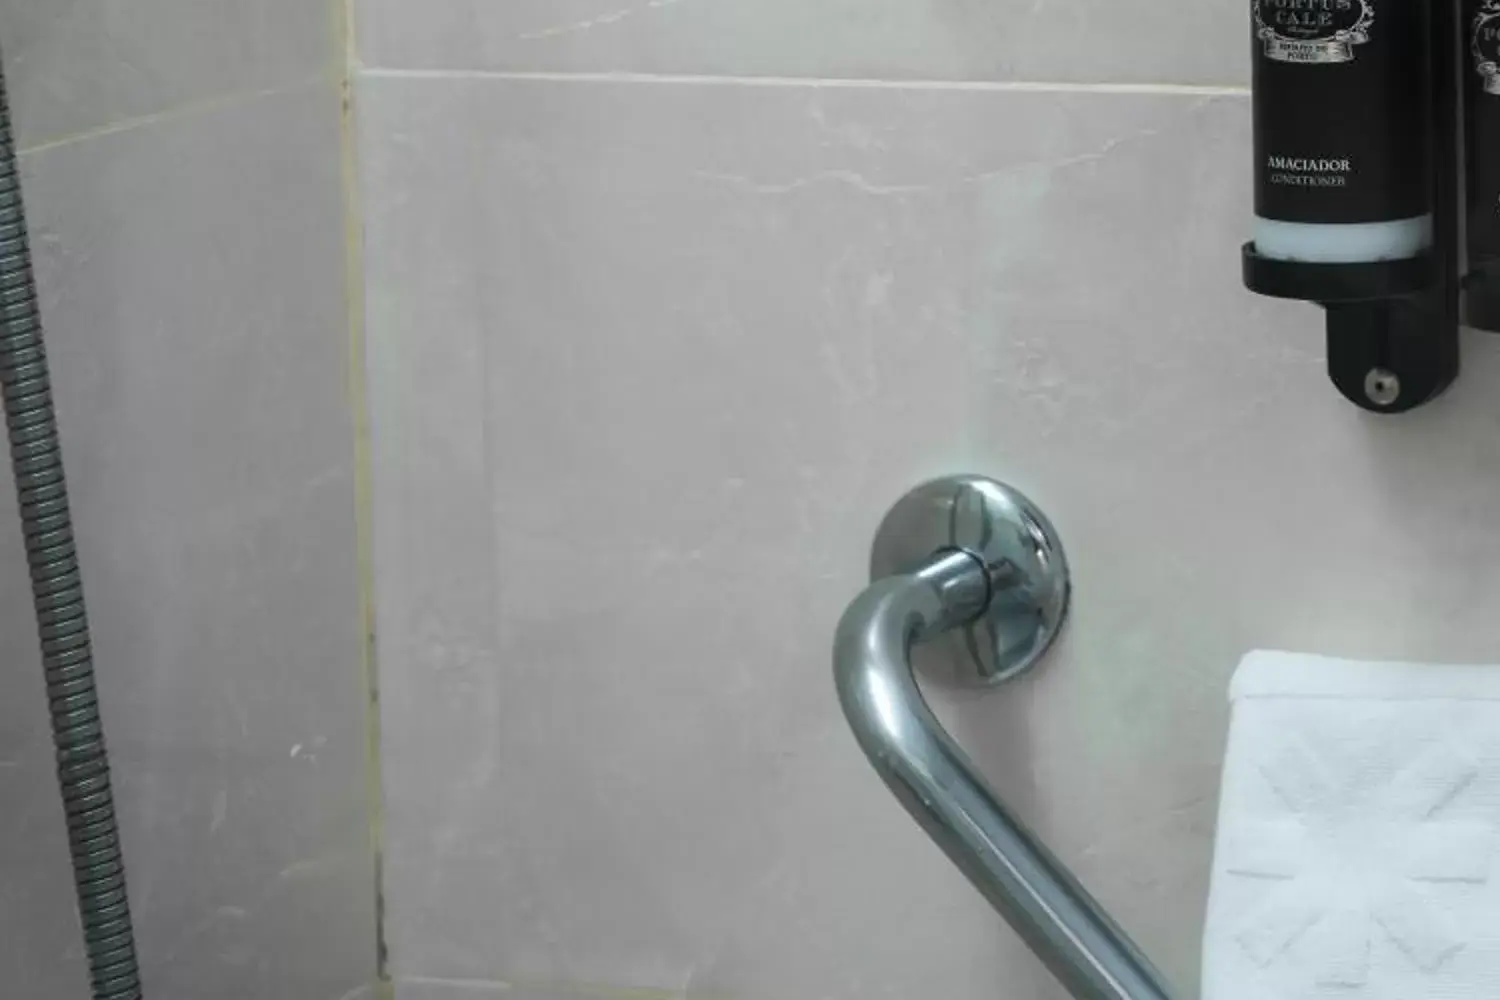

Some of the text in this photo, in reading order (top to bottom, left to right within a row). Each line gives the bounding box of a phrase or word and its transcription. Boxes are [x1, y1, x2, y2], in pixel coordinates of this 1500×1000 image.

[1276, 10, 1333, 26] CALE
[1267, 155, 1352, 172] AMACIADOR
[1271, 173, 1346, 186] CONDITIONER
